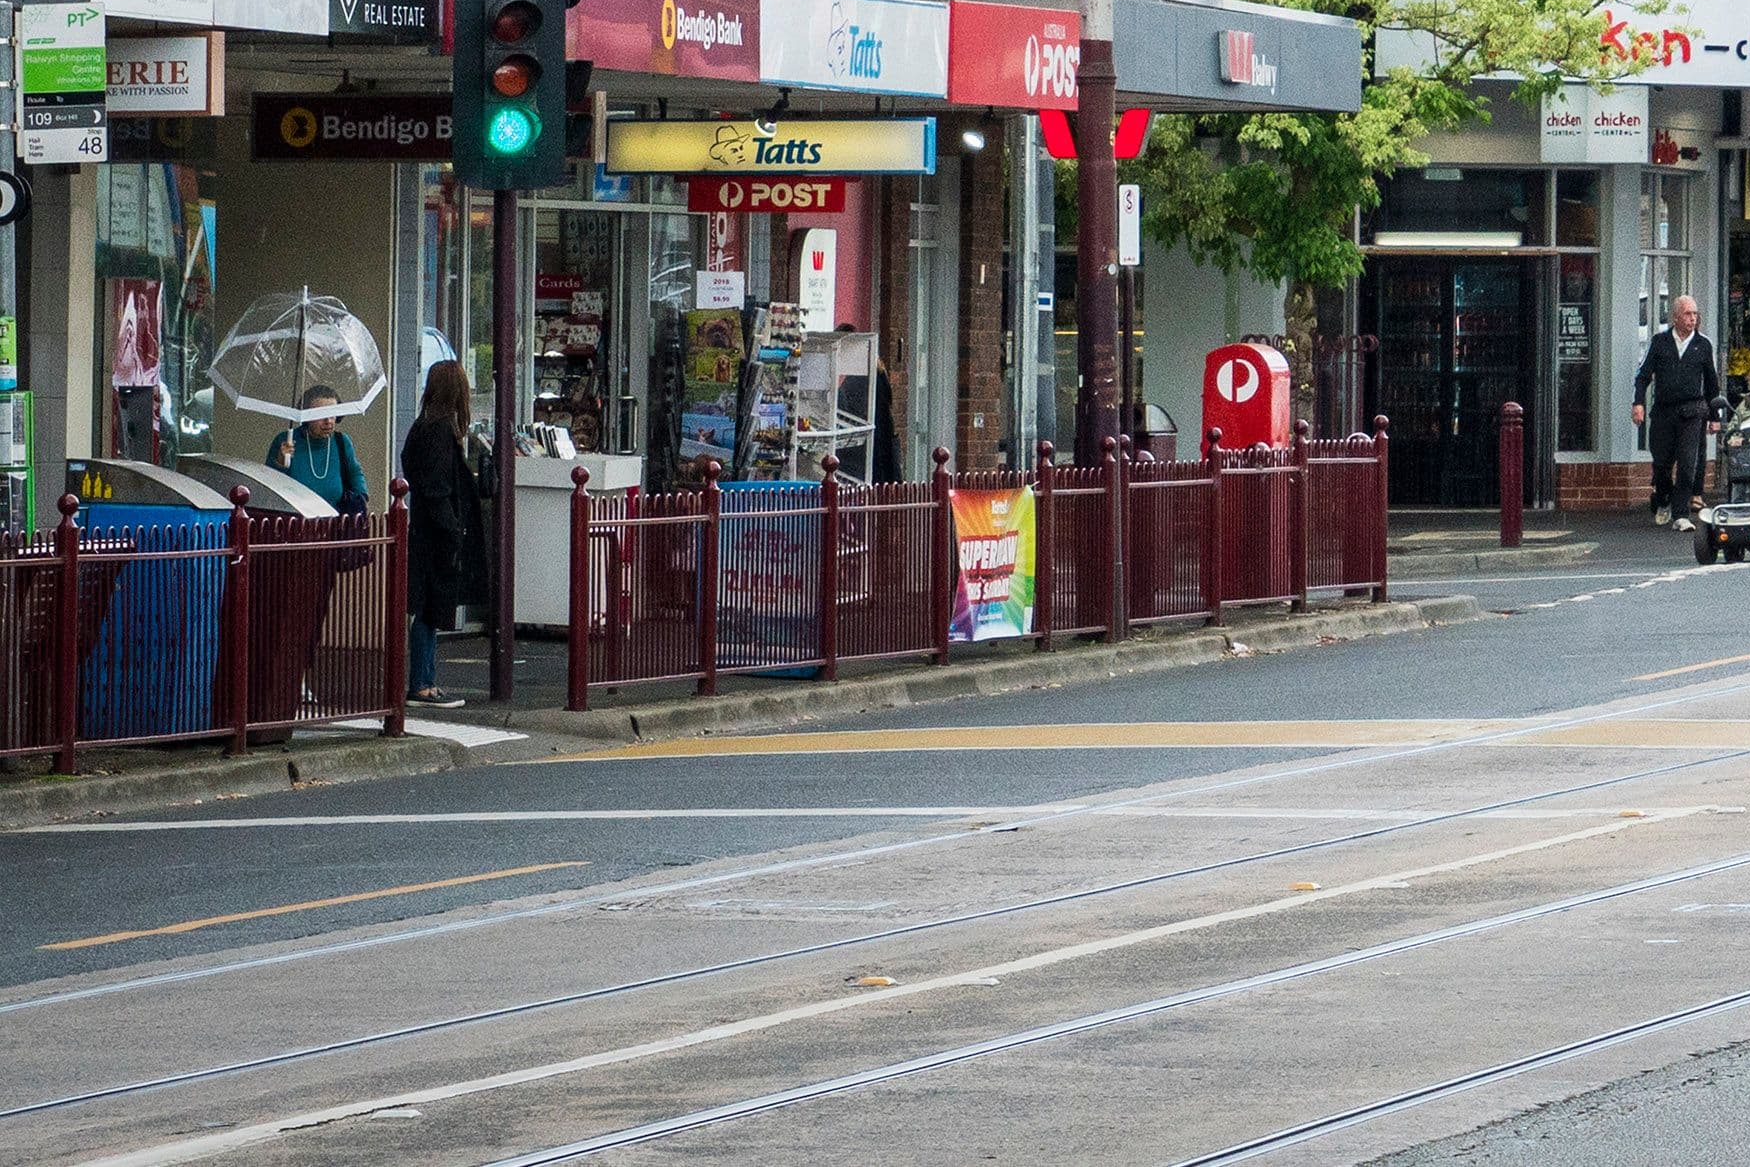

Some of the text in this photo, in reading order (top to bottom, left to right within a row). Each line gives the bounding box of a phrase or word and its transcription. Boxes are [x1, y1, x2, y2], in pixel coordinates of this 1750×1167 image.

[364, 3, 426, 28] REAL ESTATE
[676, 7, 743, 51] Bendigo Bank
[59, 53, 101, 65] Shopping
[849, 24, 884, 80] Tatts
[121, 87, 146, 97] WITH
[148, 86, 189, 97] PASSION
[27, 112, 52, 126] 109
[1546, 112, 1582, 127] chicken
[1594, 112, 1641, 127] chicken
[323, 115, 429, 145] Bendigo
[78, 136, 103, 155] 48
[751, 136, 823, 165] Tatts
[751, 183, 831, 207] POST
[540, 277, 580, 288] Cards
